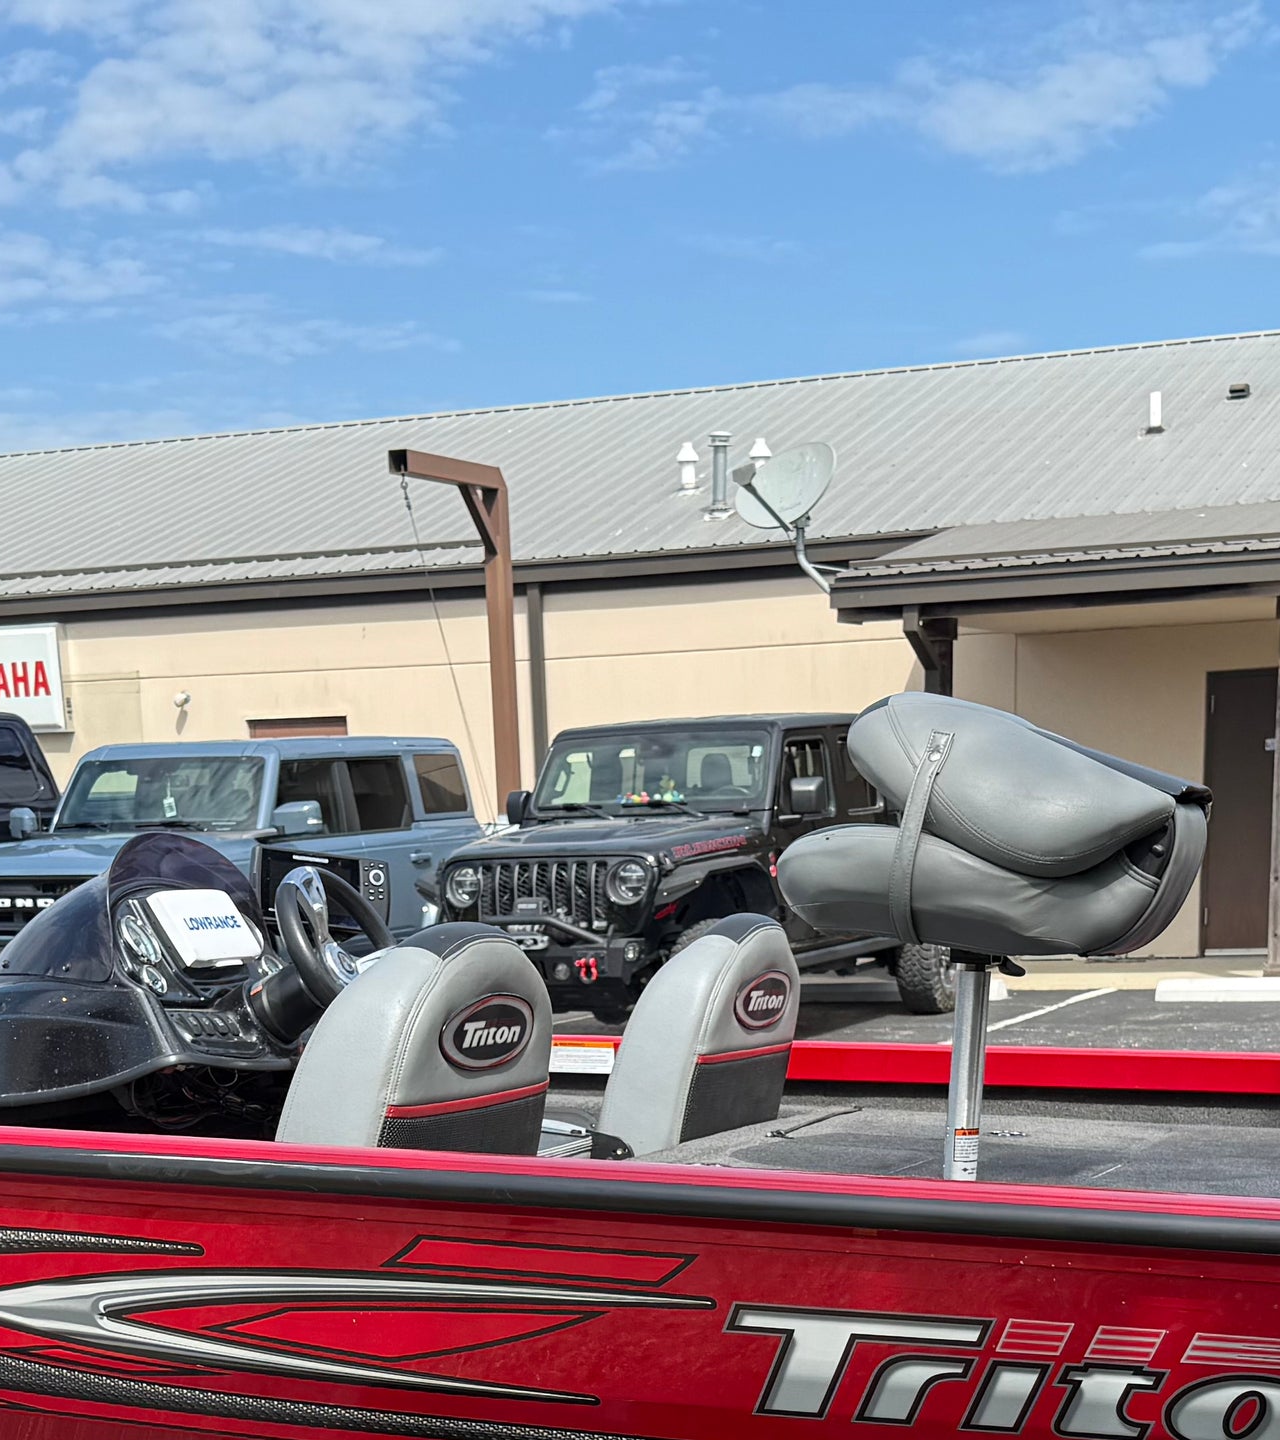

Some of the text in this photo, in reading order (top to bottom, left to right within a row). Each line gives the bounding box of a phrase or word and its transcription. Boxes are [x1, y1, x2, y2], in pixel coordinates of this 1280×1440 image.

[183, 915, 241, 931] LOWRANCE
[747, 989, 785, 1012] Triton
[462, 1020, 521, 1049] Triton
